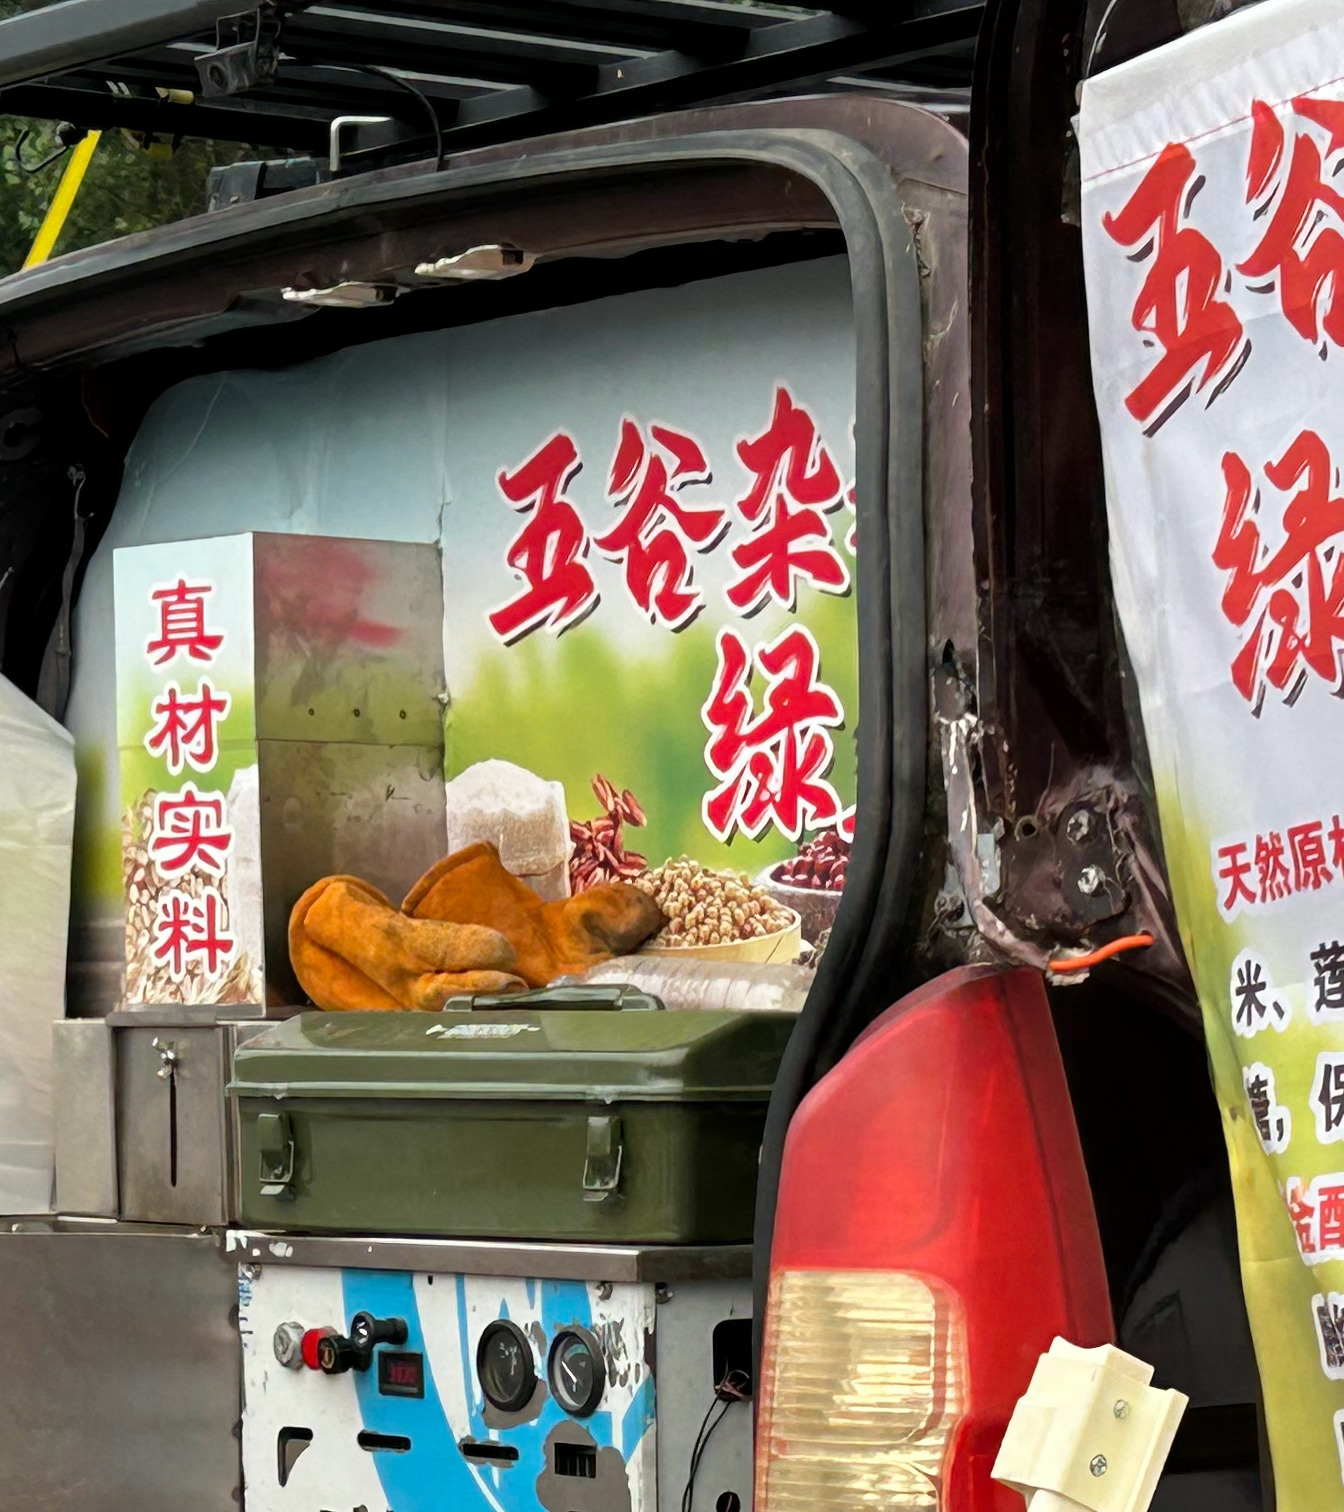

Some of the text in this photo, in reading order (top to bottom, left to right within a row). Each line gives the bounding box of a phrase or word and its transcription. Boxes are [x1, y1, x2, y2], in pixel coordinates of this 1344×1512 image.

[488, 387, 856, 640] 五谷杂
[146, 578, 236, 977] 真材实料
[706, 631, 856, 833] 绿
